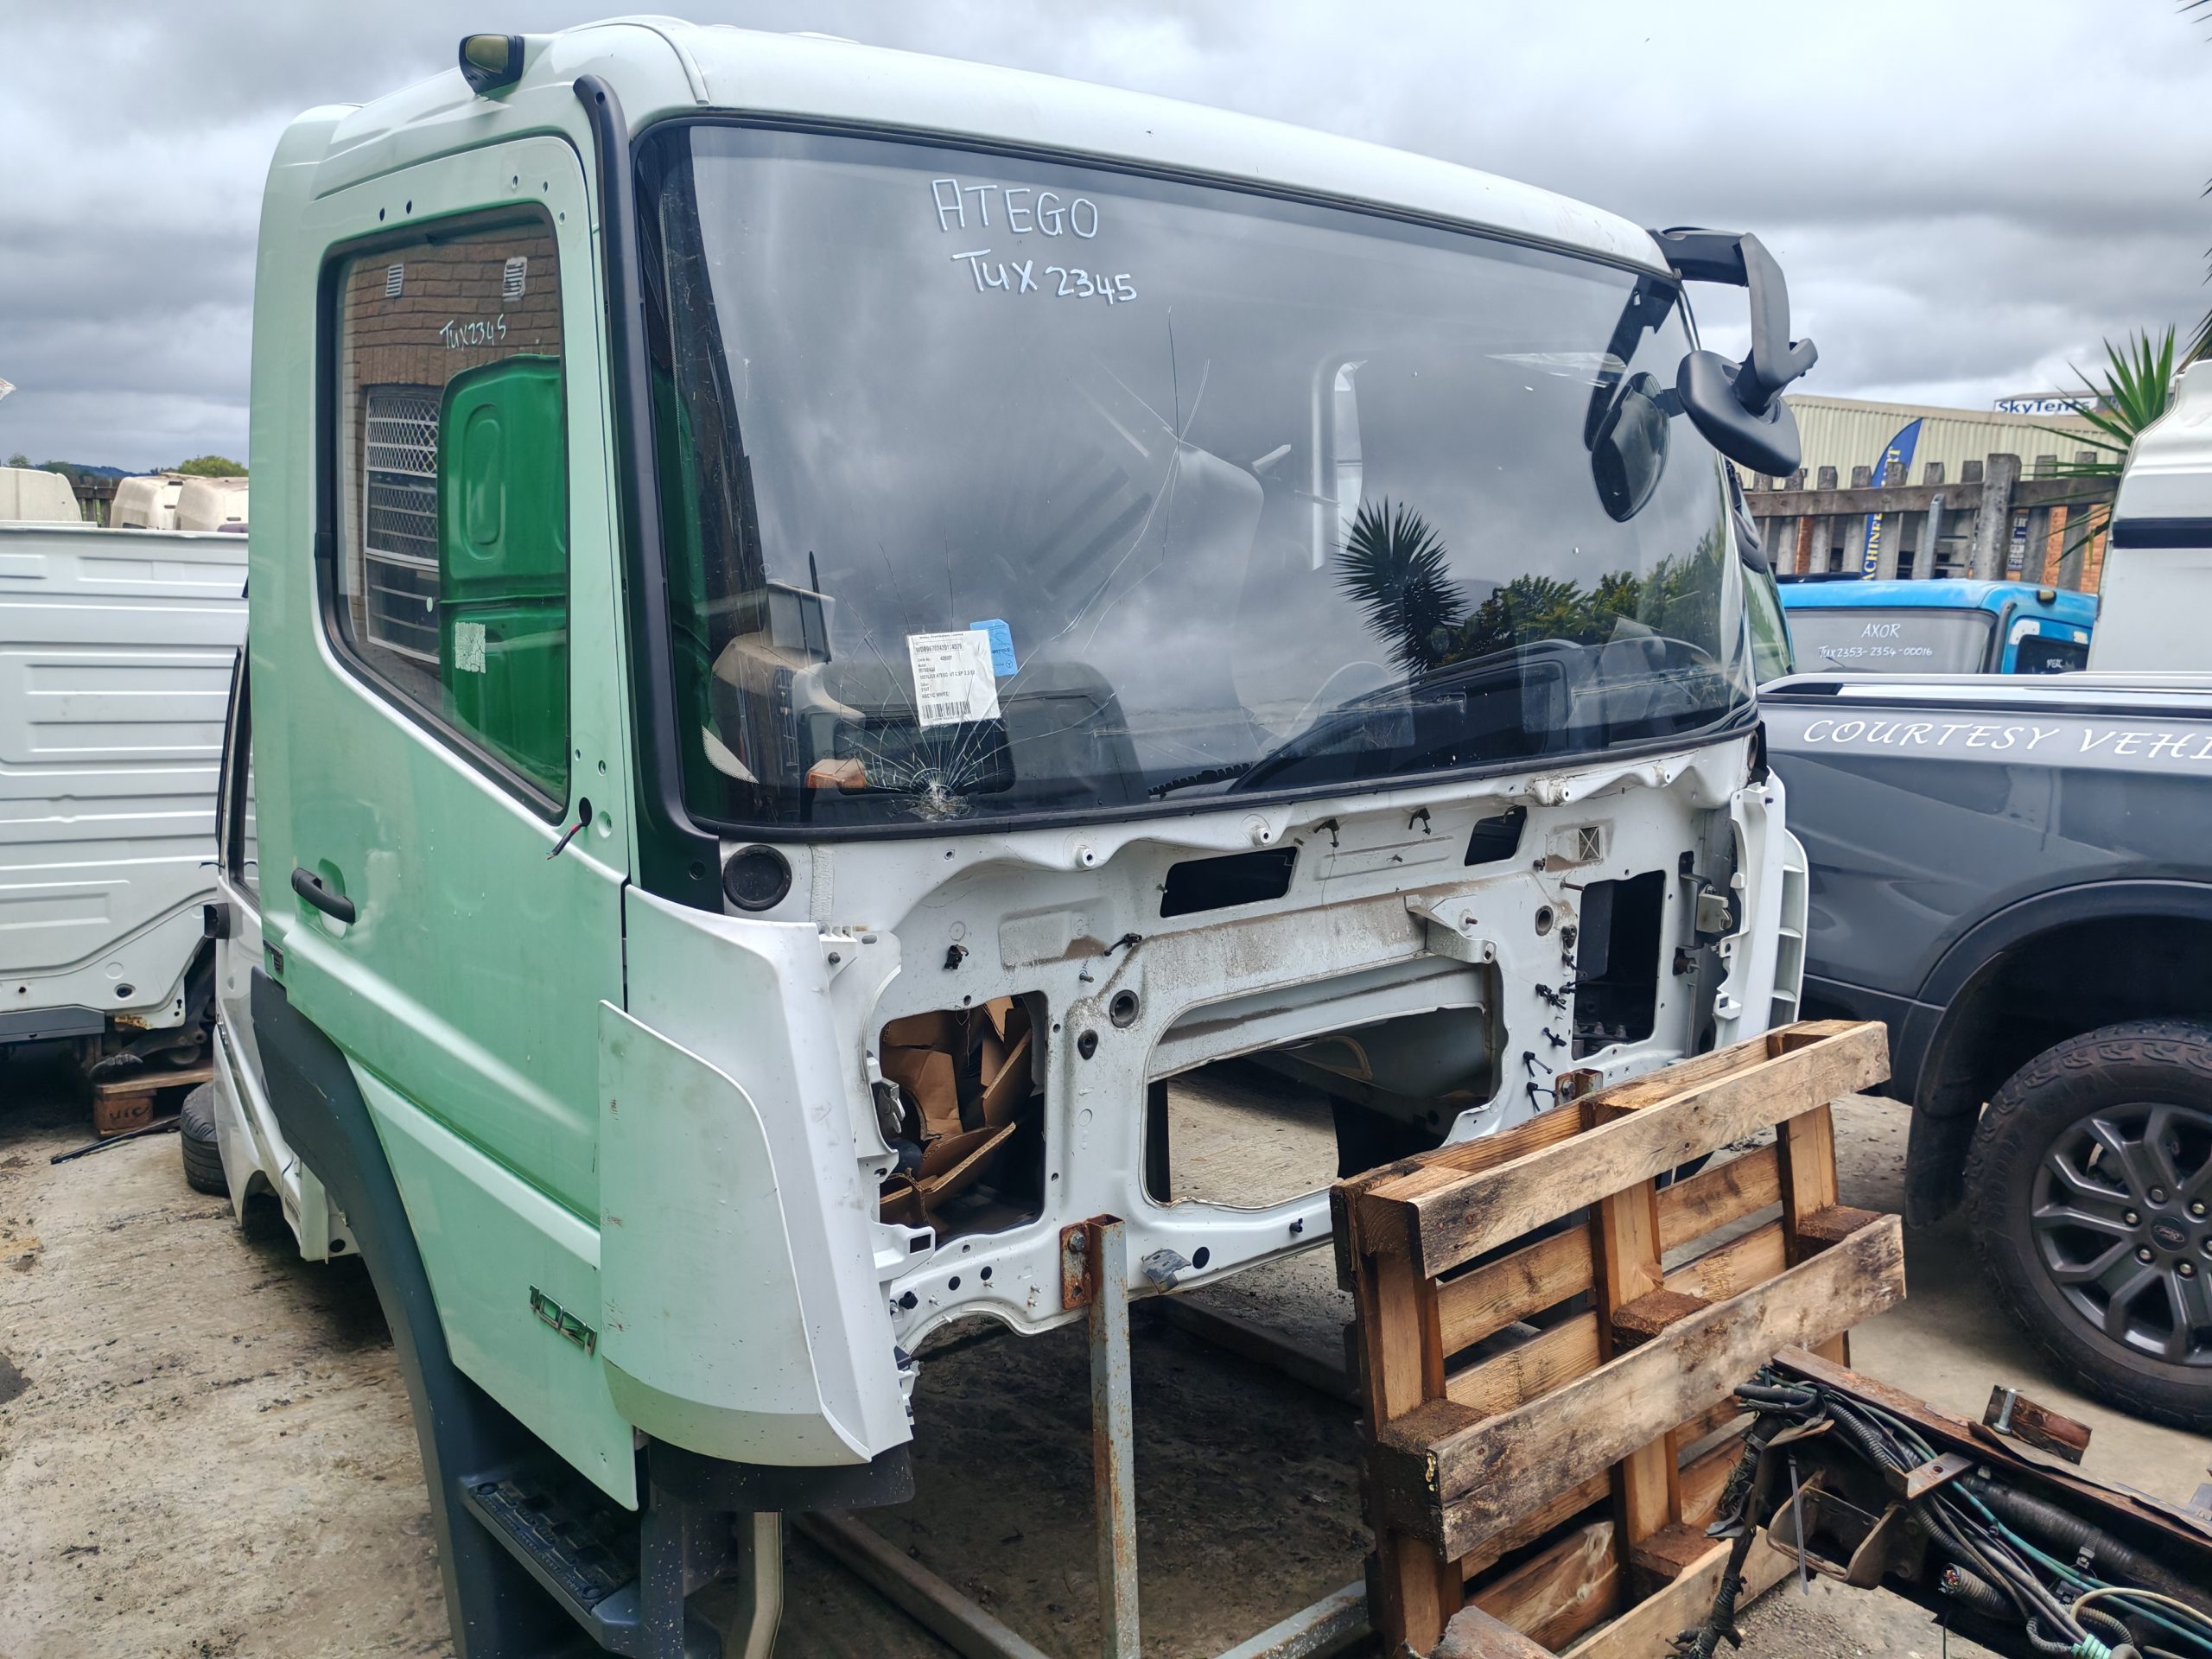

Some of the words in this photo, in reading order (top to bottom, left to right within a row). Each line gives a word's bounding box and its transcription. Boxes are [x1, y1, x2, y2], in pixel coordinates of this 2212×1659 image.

[931, 178, 1098, 238] ATEGO
[1045, 265, 1137, 304] 2345
[1860, 622, 1901, 638] AXOR
[1803, 720, 2060, 750] COURTESY
[530, 1283, 597, 1355] 1021
